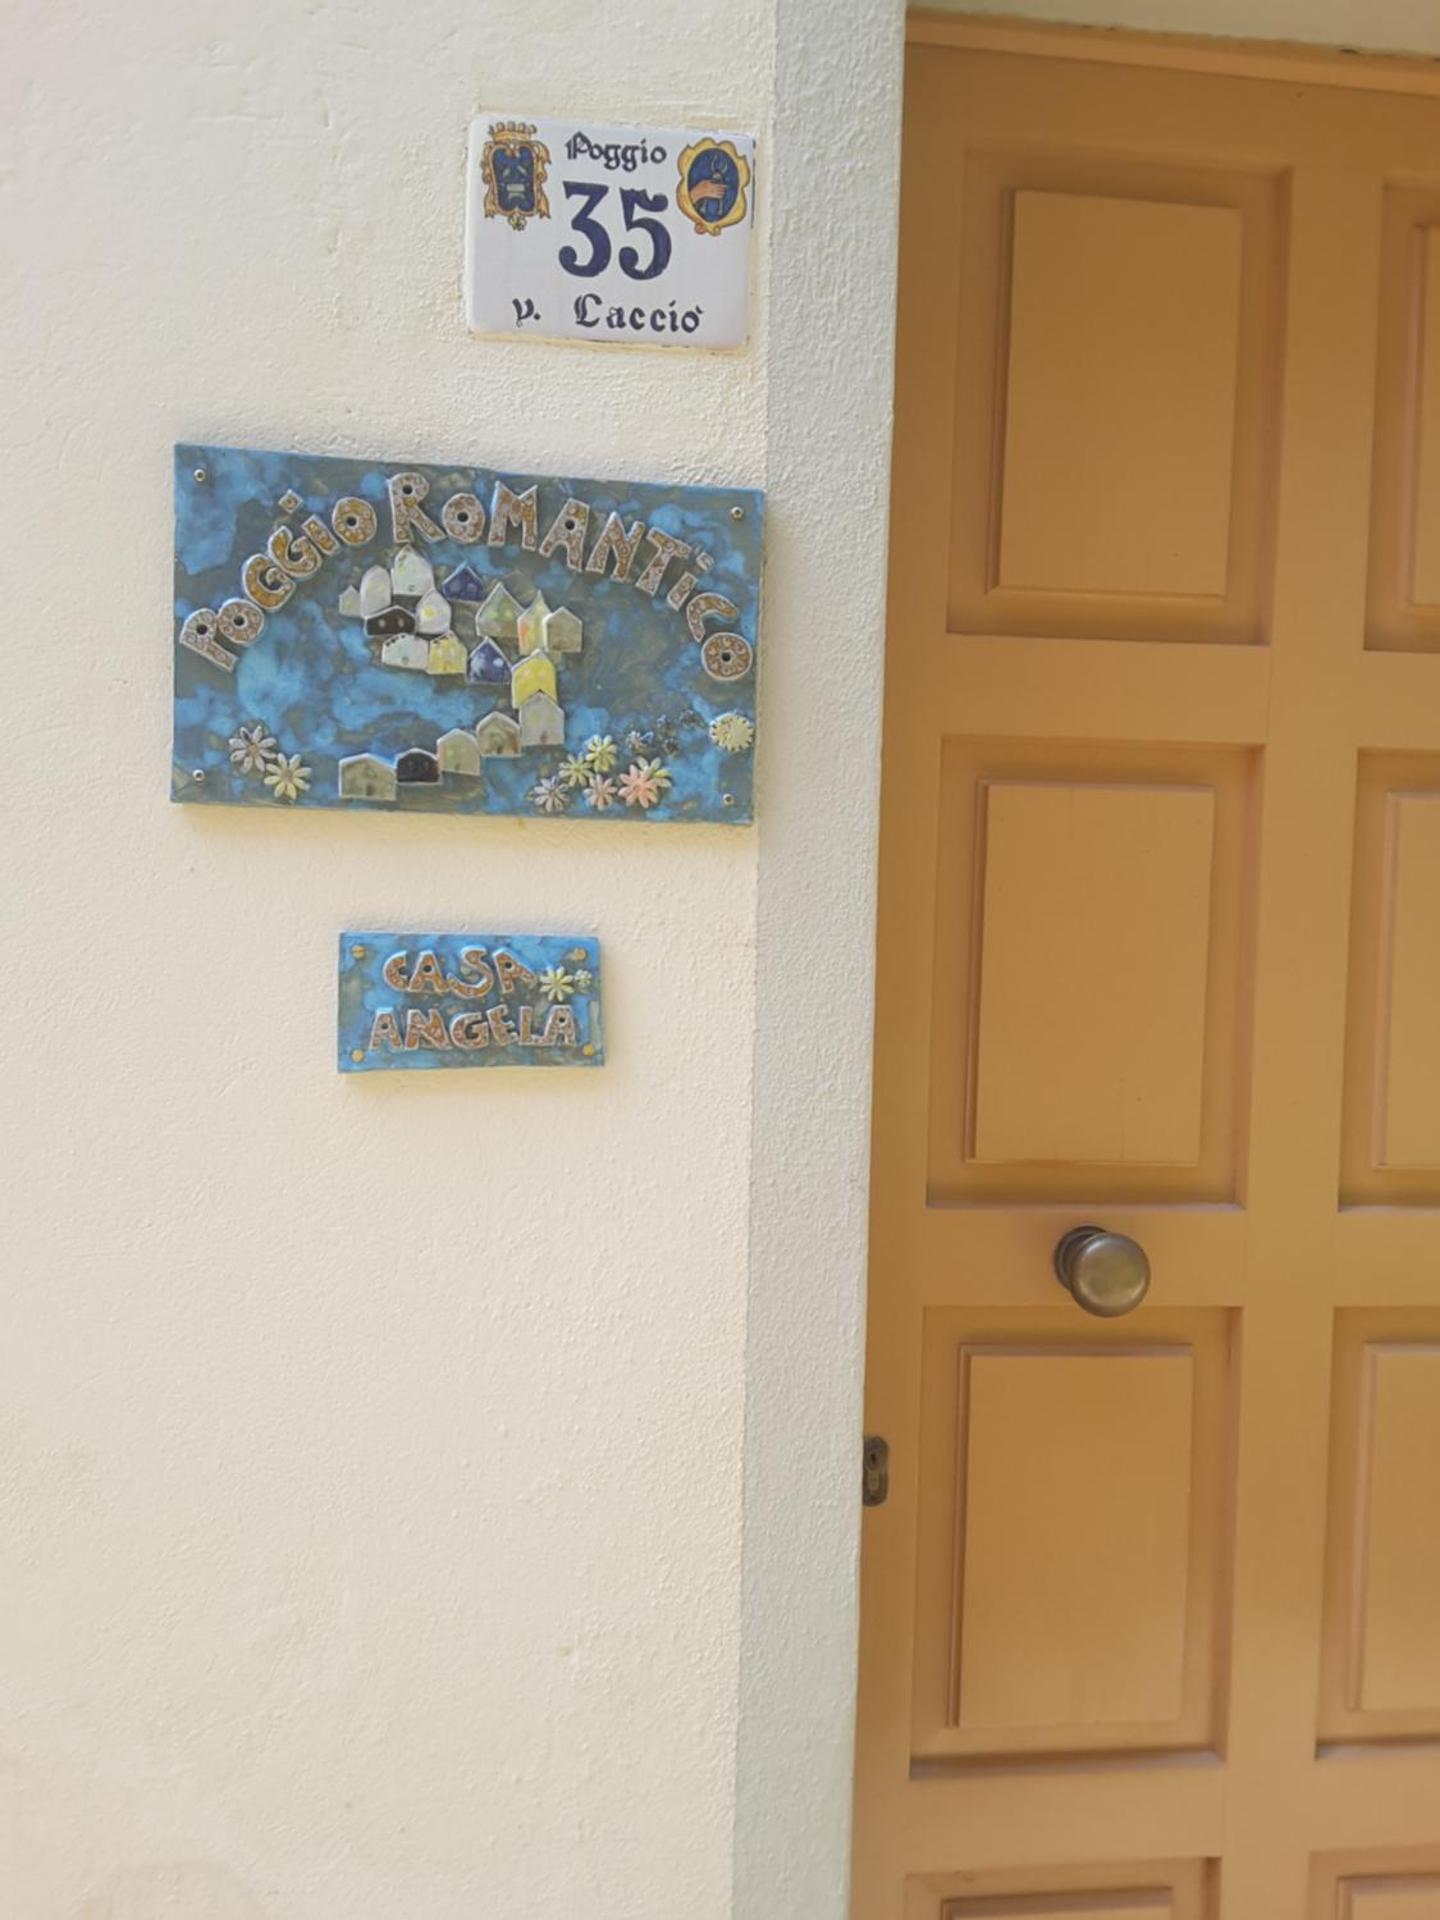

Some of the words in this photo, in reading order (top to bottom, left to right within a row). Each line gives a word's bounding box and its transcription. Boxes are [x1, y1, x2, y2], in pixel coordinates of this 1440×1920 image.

[565, 131, 667, 172] Poggio
[558, 181, 672, 280] 35
[383, 945, 538, 998] CASA
[369, 1004, 578, 1050] ANGELA
